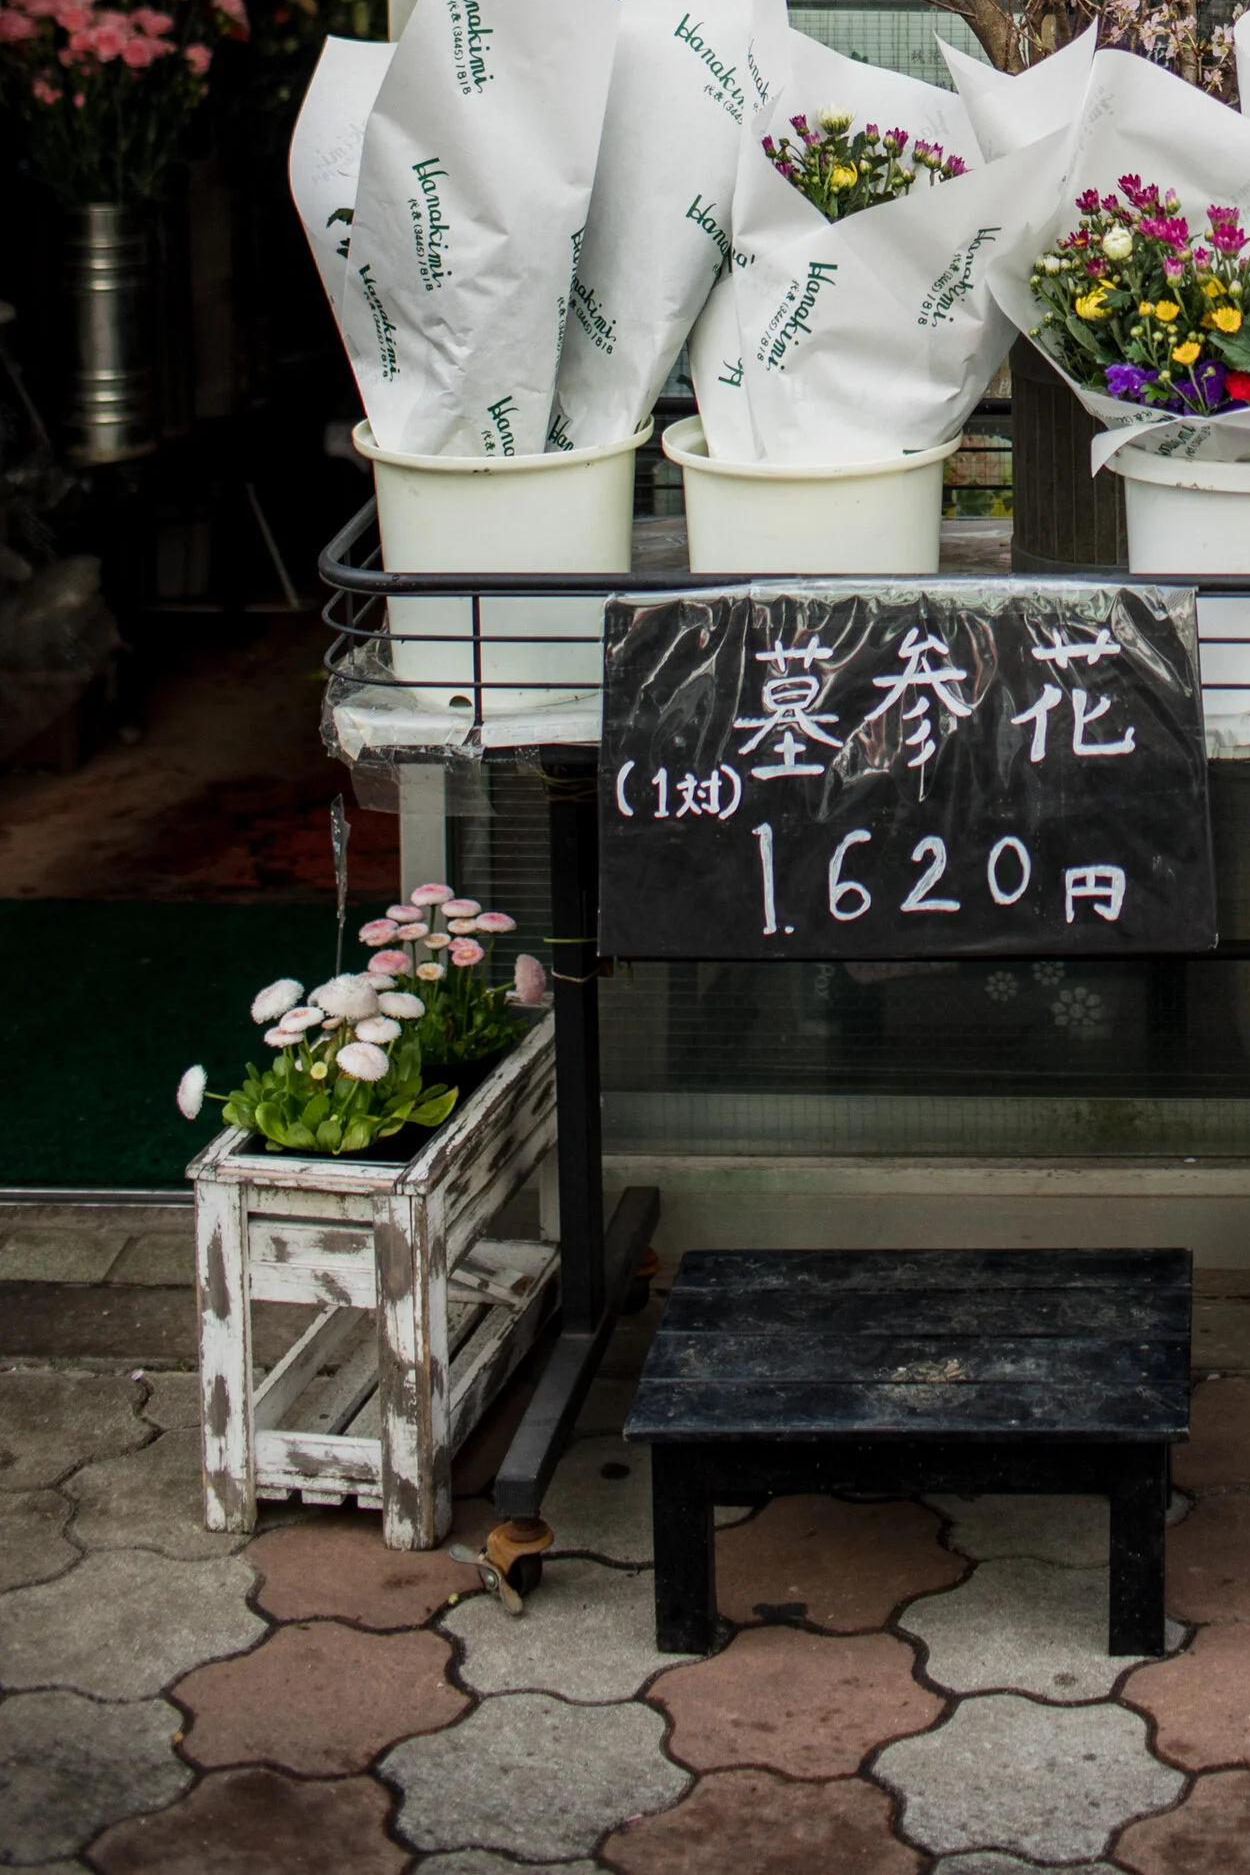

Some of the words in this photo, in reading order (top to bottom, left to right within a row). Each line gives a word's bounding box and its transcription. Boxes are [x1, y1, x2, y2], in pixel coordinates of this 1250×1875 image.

[411, 157, 453, 288] Hanakimi
[931, 227, 1002, 328] Hanakimi
[358, 264, 401, 382] Hanakimi
[765, 261, 838, 372] Hanakimi
[734, 628, 1135, 803] 墓参花
[616, 760, 742, 820] (1対)
